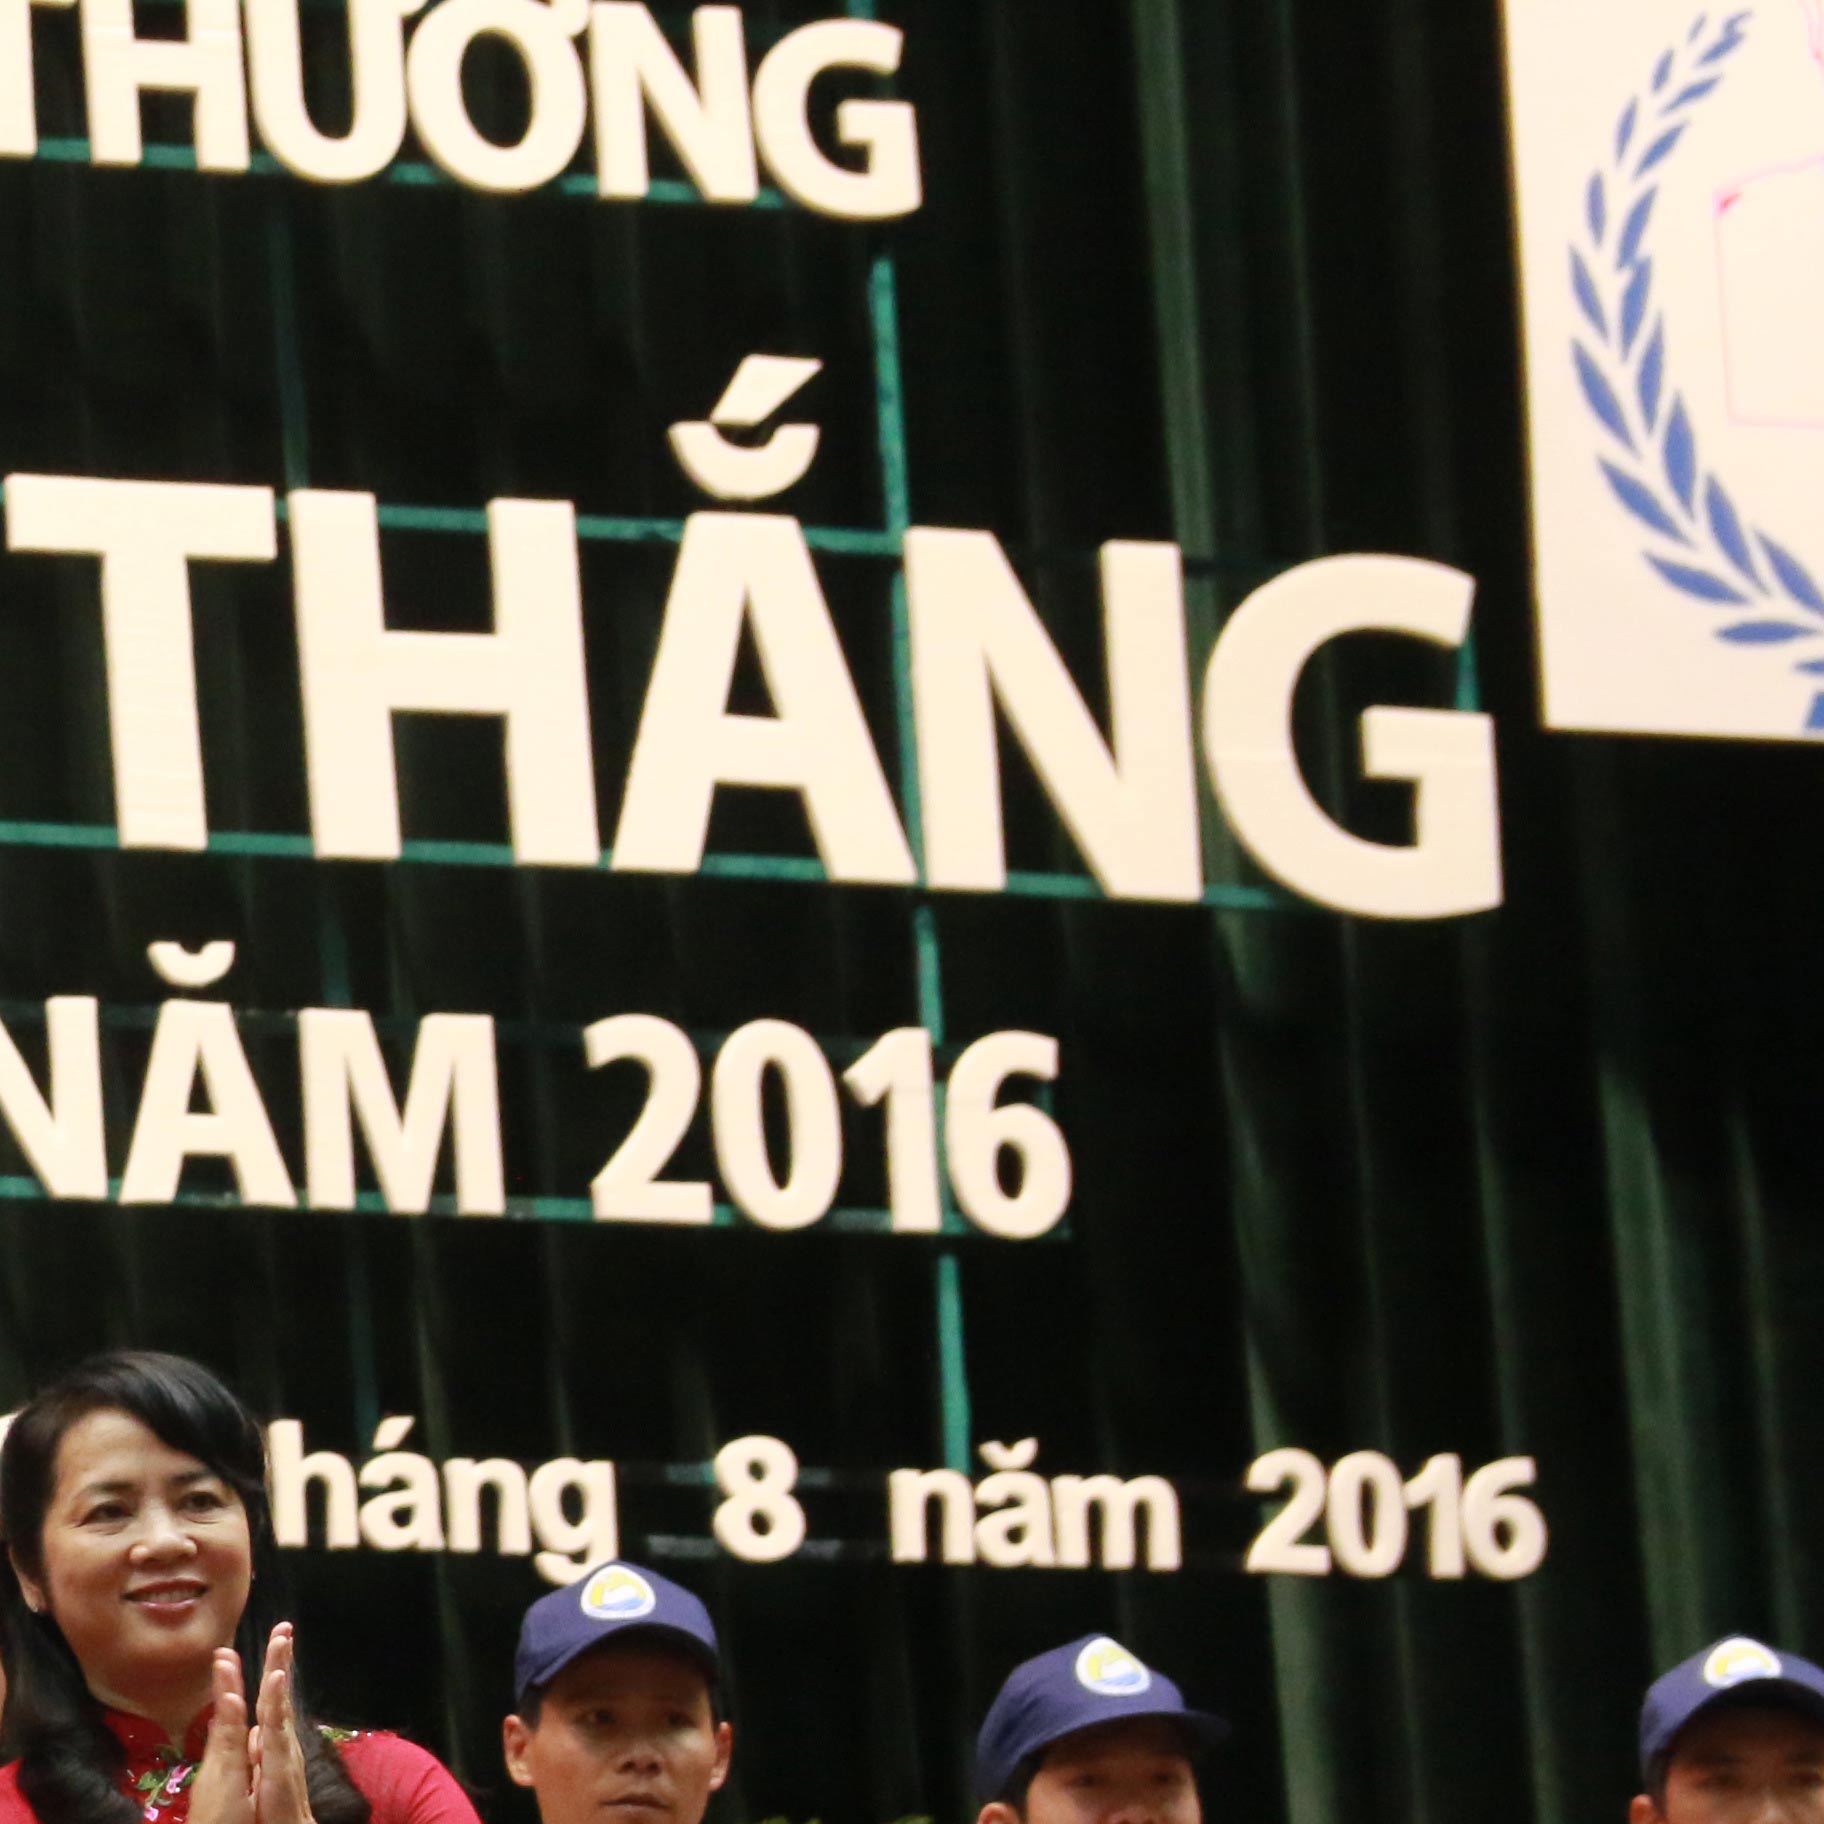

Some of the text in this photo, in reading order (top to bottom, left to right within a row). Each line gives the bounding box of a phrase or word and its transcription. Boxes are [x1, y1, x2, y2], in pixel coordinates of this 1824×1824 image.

[3, 355, 1503, 919] THẮNG
[585, 1014, 1070, 1237] 2016
[268, 1415, 618, 1584] háng
[713, 1436, 806, 1560] 8
[890, 1438, 1181, 1570] năm
[1247, 1449, 1546, 1579] 2016
